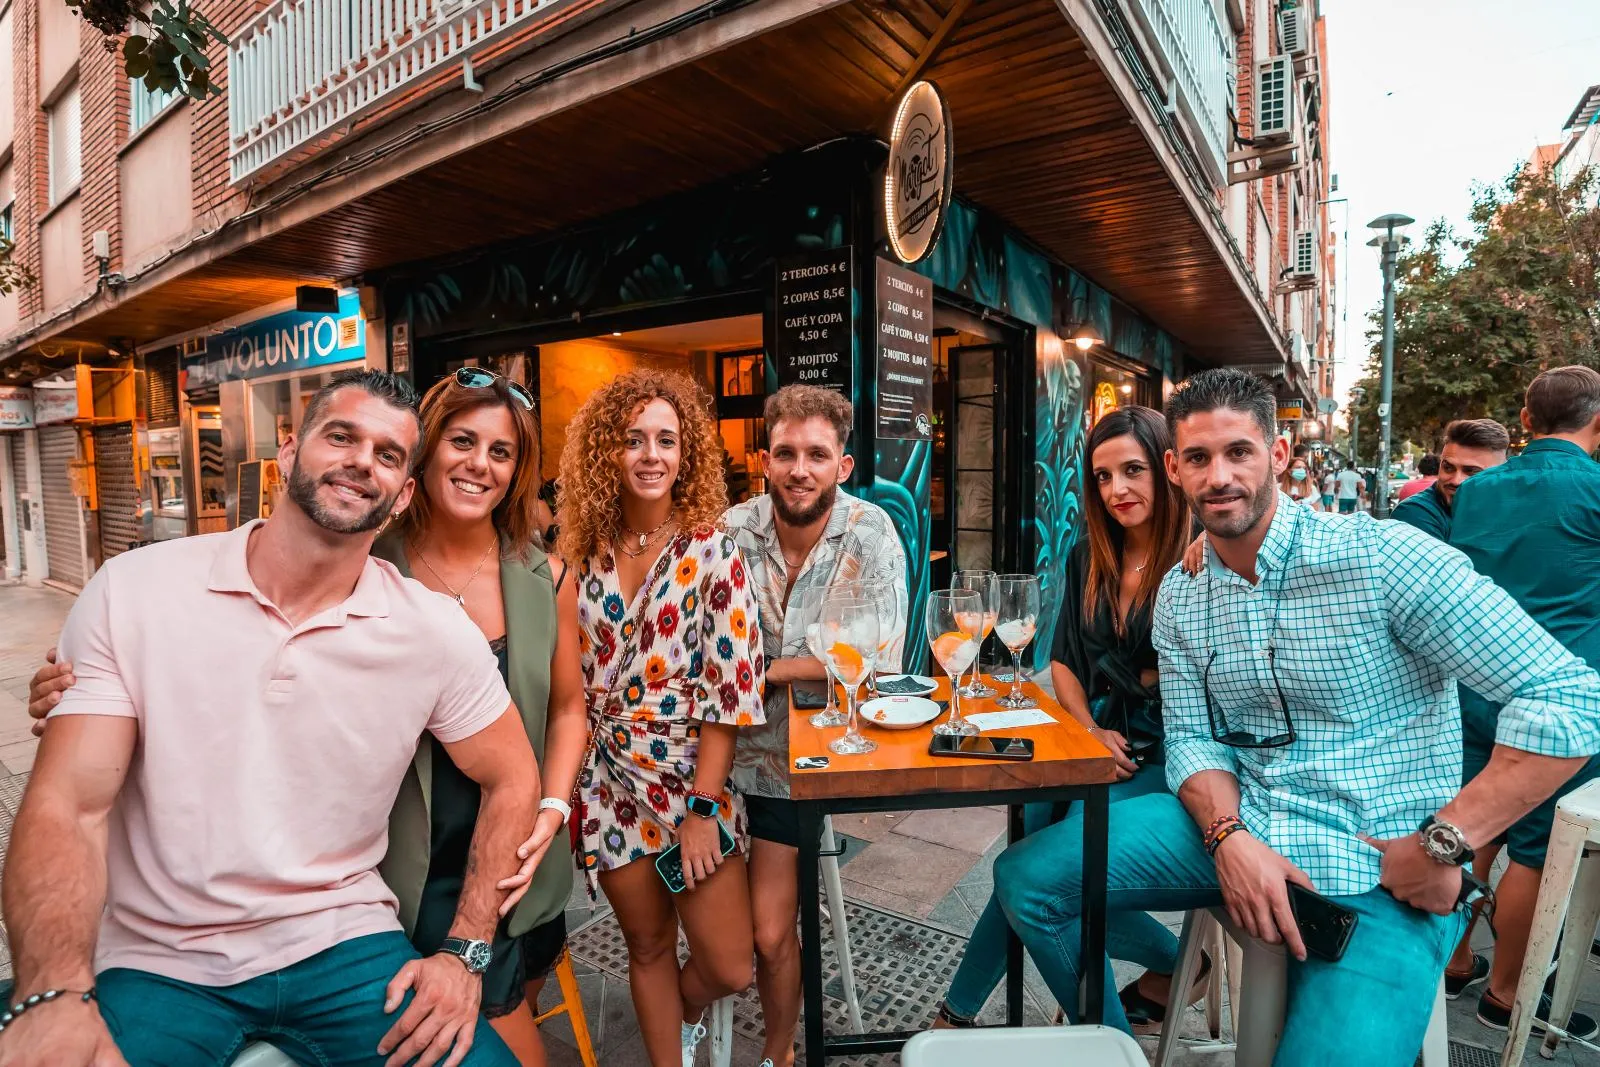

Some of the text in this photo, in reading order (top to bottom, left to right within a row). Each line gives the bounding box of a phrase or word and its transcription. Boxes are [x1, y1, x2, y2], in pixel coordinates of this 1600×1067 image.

[782, 261, 846, 281] 2 TERCIOS 4 €
[891, 277, 914, 294] TERCIOS
[783, 295, 789, 305] 2
[790, 290, 820, 304] COPAS
[892, 302, 909, 316] COPAS
[785, 312, 843, 328] CAFÉ Y COPA
[799, 328, 828, 342] 4,50 €
[881, 322, 895, 335] CAFÉ
[899, 328, 913, 340] COPA
[223, 315, 338, 374] VOLUNTO
[789, 352, 839, 366] 2 MOJITOS
[887, 348, 910, 363] MOJITOS
[799, 368, 828, 381] 8,00 €
